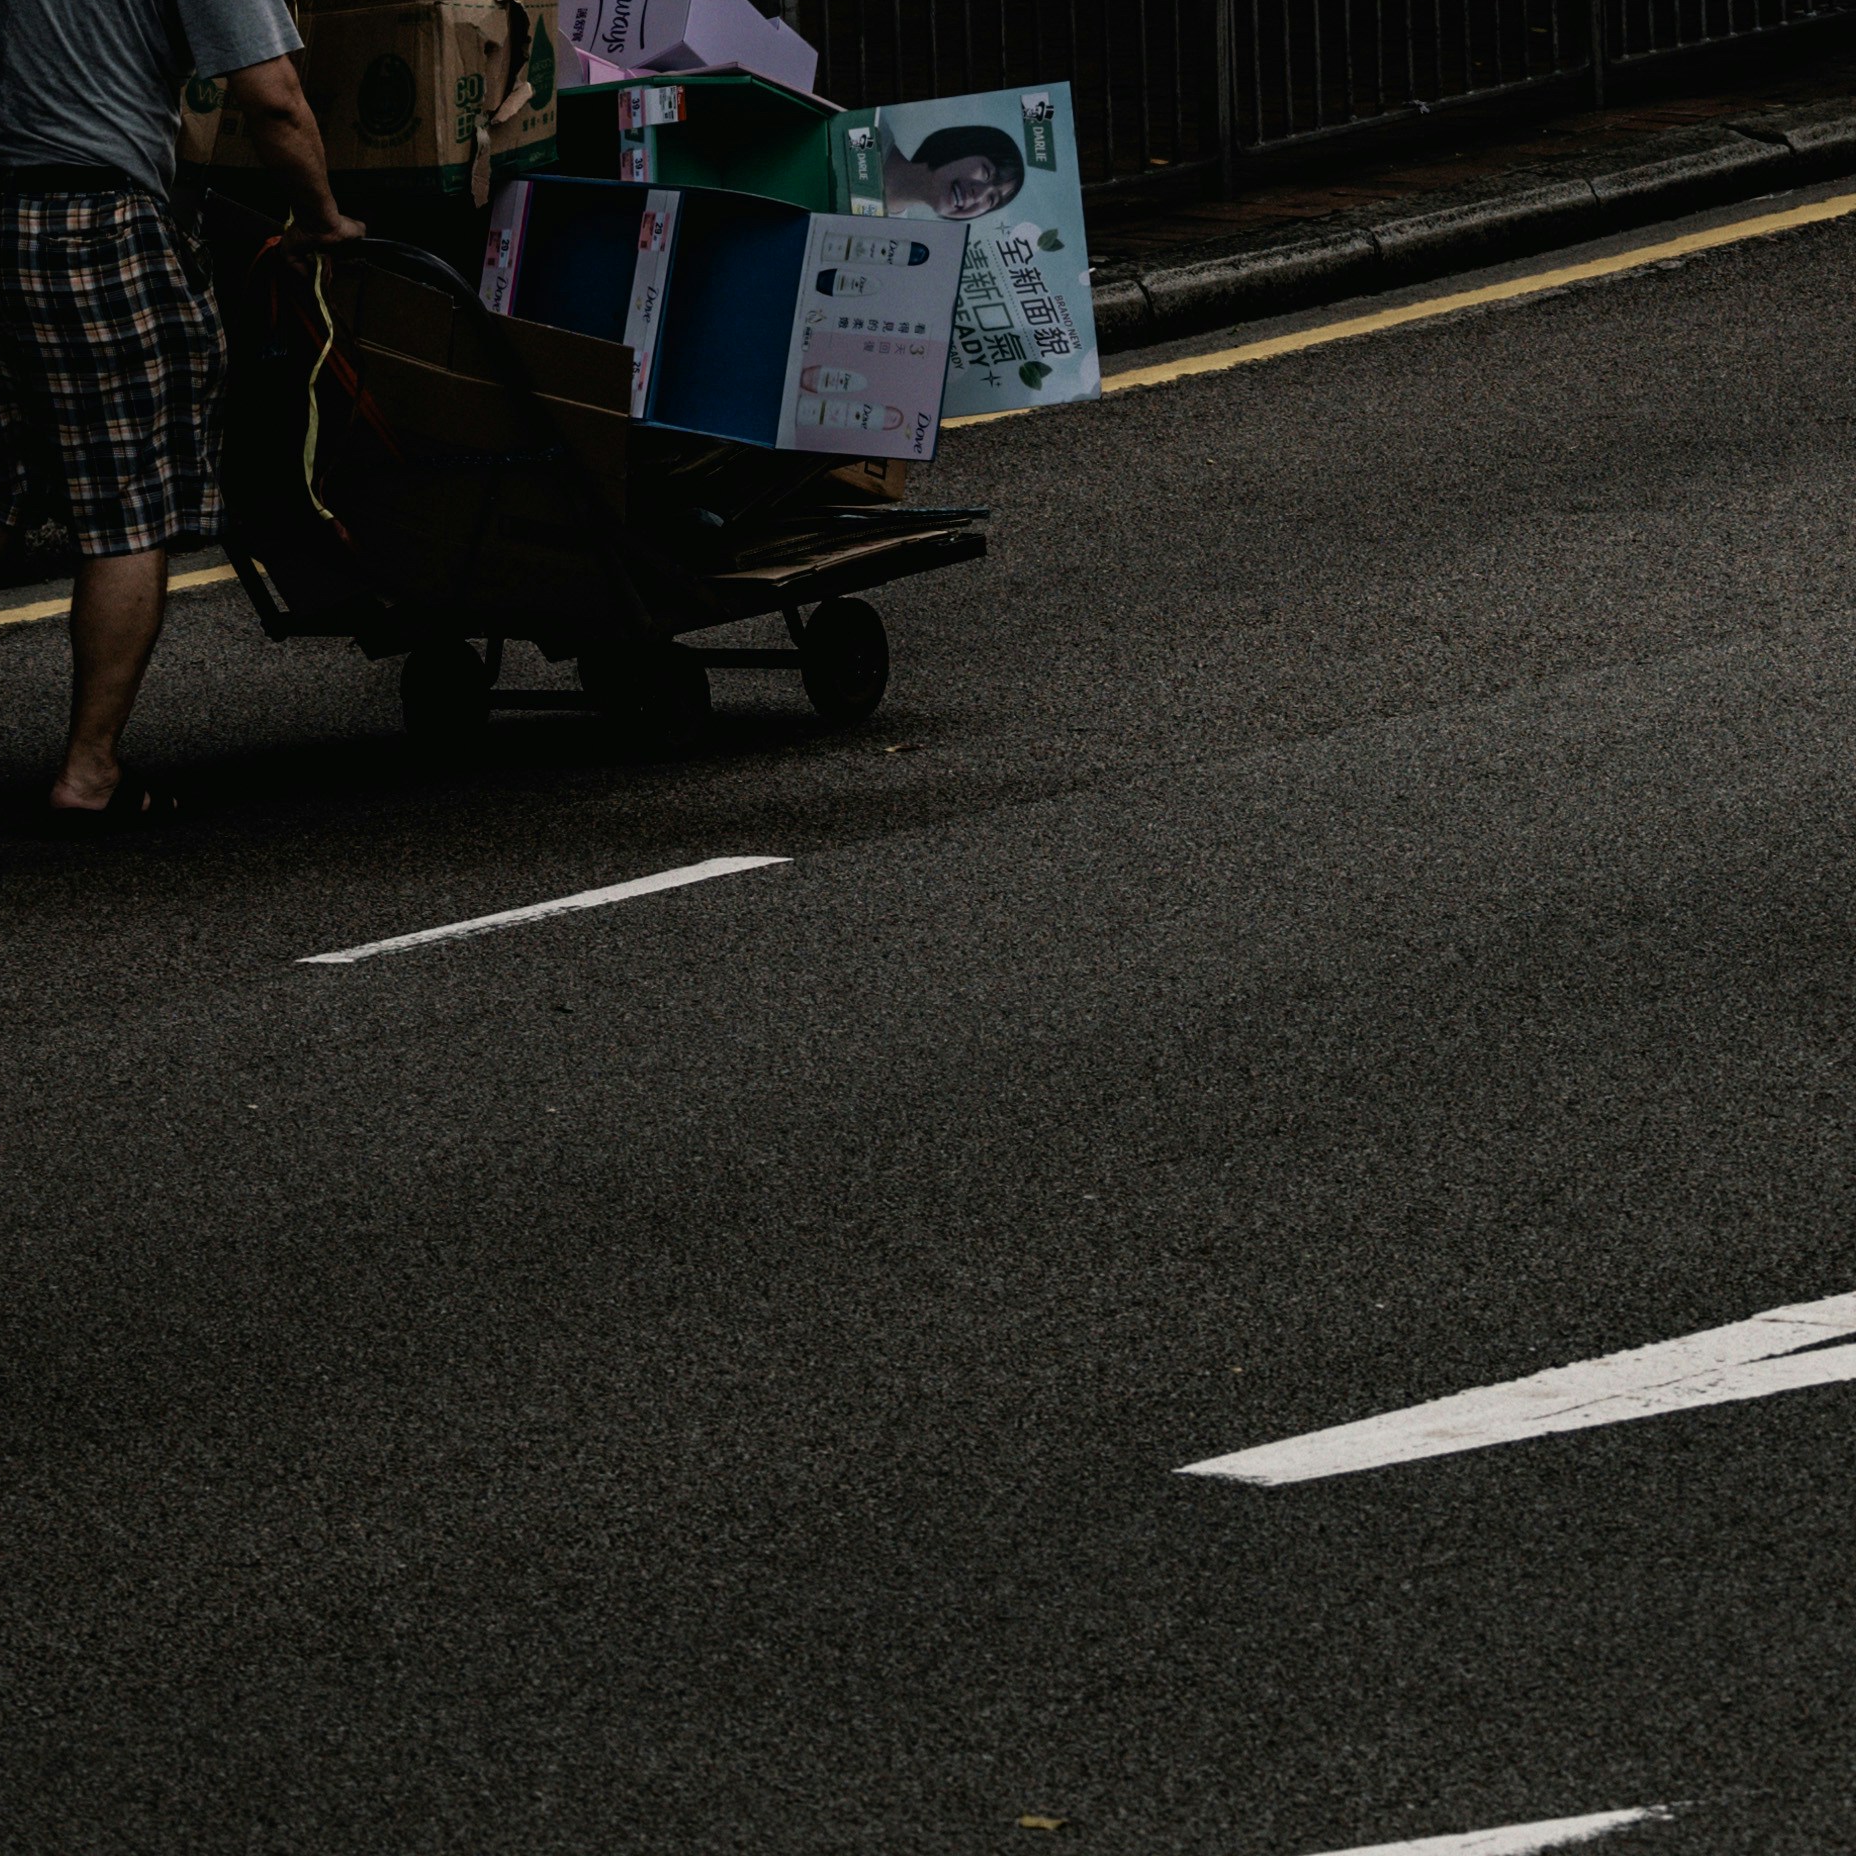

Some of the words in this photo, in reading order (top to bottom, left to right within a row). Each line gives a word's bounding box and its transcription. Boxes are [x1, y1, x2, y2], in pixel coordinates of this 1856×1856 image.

[1032, 125, 1048, 163] DARLIE
[856, 152, 869, 181] DARLIE
[494, 276, 508, 313] Dove
[642, 285, 660, 324] Dove
[995, 237, 1070, 358] 全新面貌
[1054, 295, 1074, 327] BRAND
[1068, 327, 1082, 350] NEW
[861, 403, 873, 431] Dove
[913, 411, 932, 455] Dove
